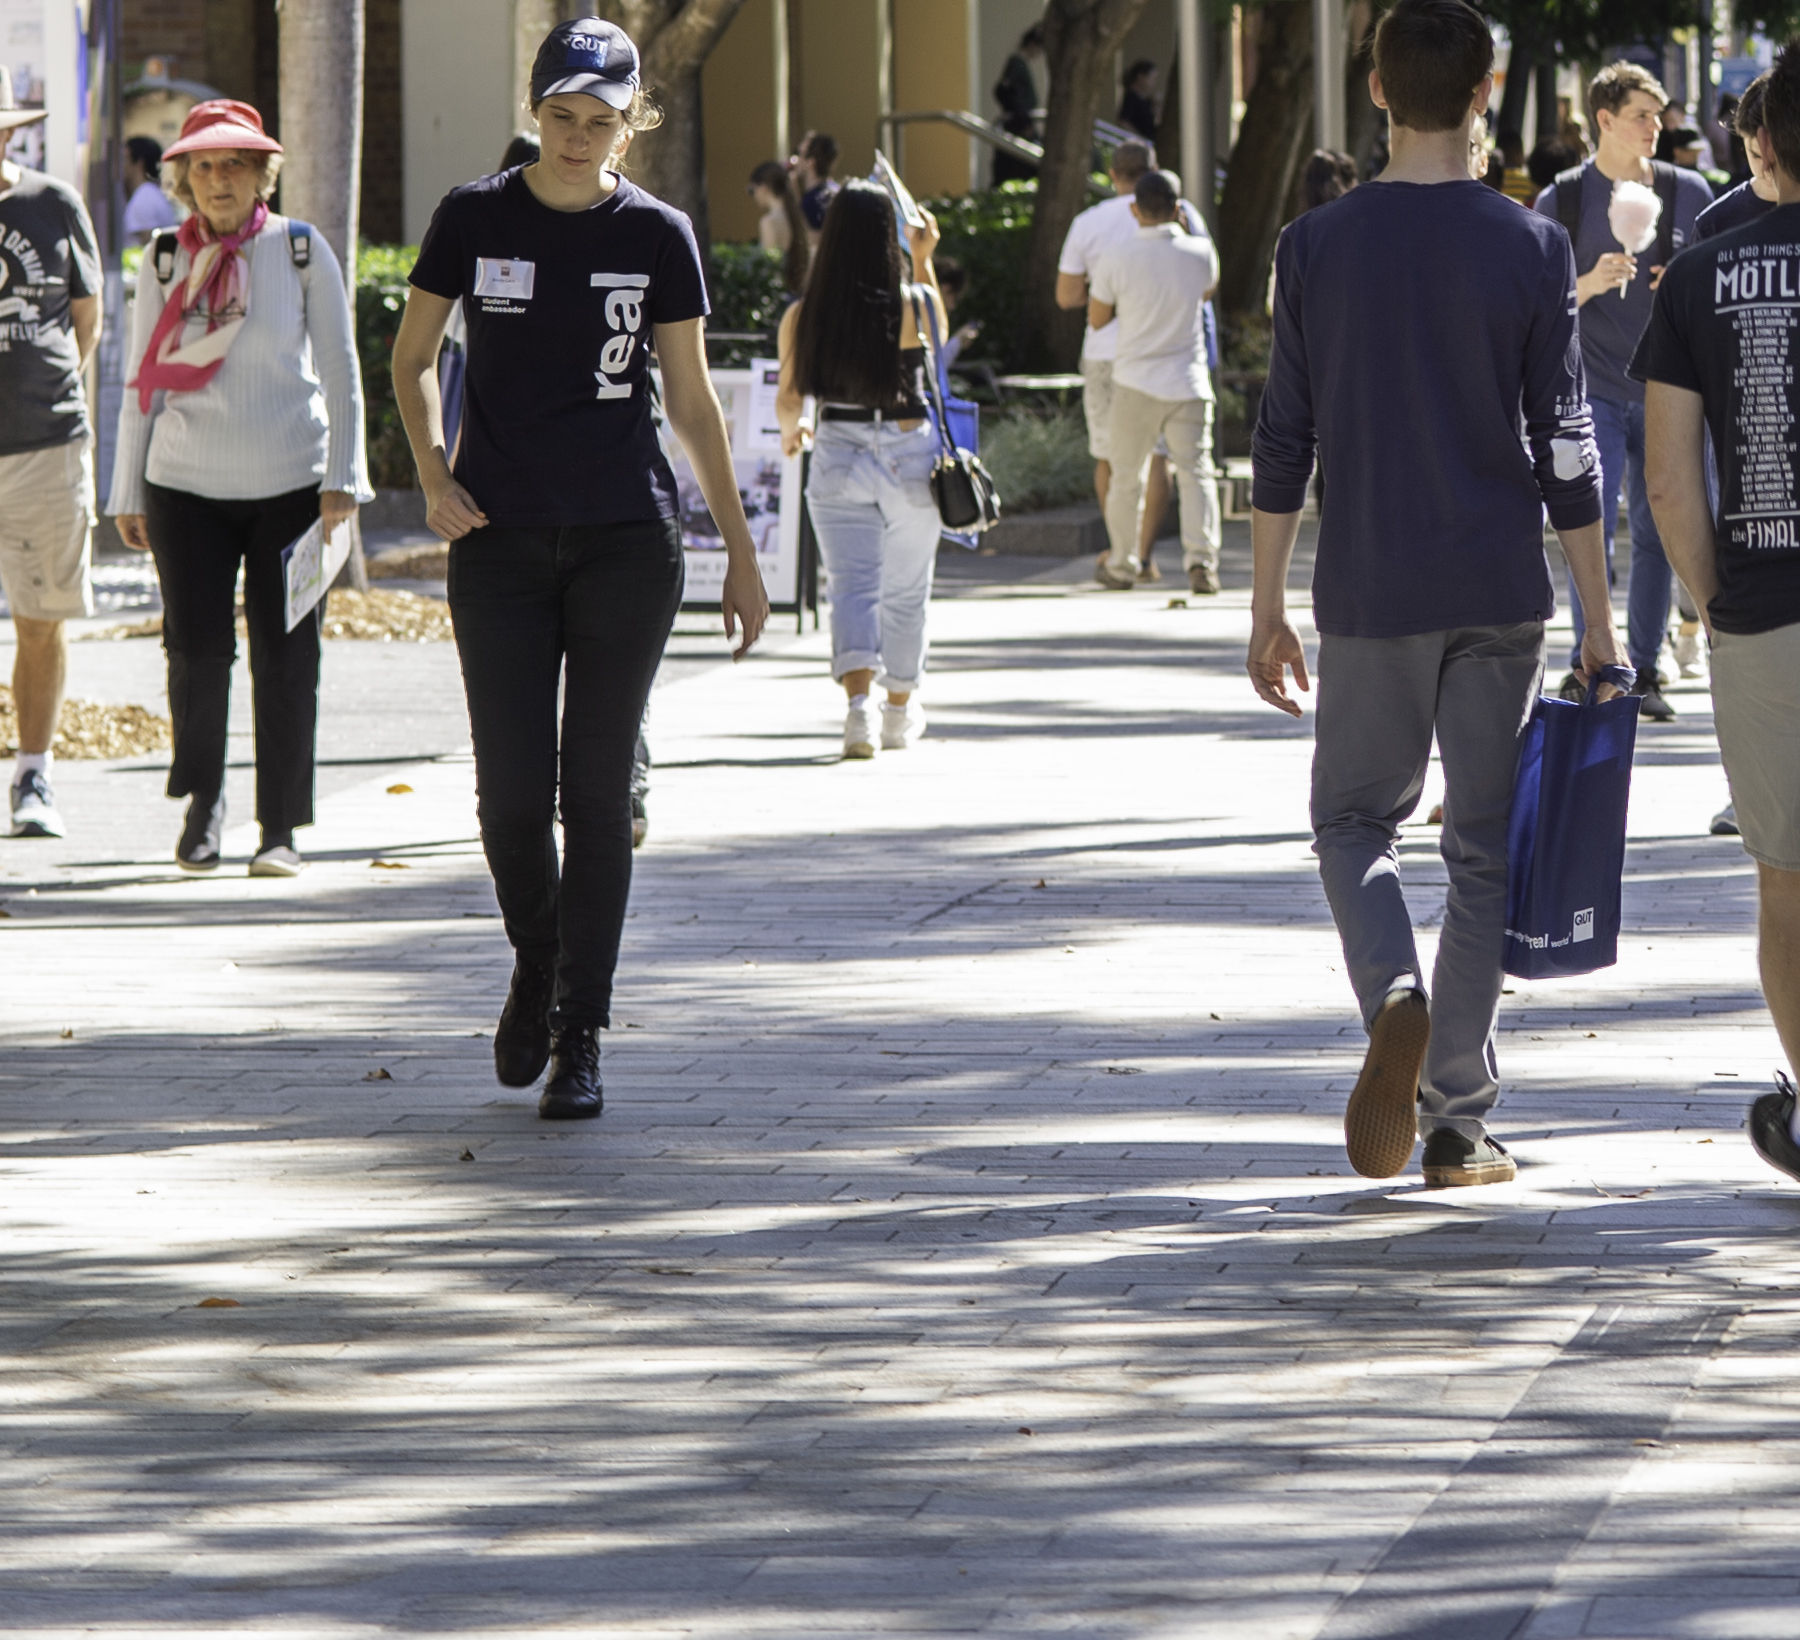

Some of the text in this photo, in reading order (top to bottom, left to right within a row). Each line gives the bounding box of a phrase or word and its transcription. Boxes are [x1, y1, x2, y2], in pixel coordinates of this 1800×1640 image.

[571, 37, 608, 55] QUT
[1717, 250, 1735, 264] ALL
[1739, 245, 1759, 259] BAD
[590, 273, 650, 400] real
[1731, 526, 1747, 543] the
[1746, 519, 1800, 549] FINAL
[1575, 911, 1593, 926] QUT
[1529, 933, 1549, 949] real
